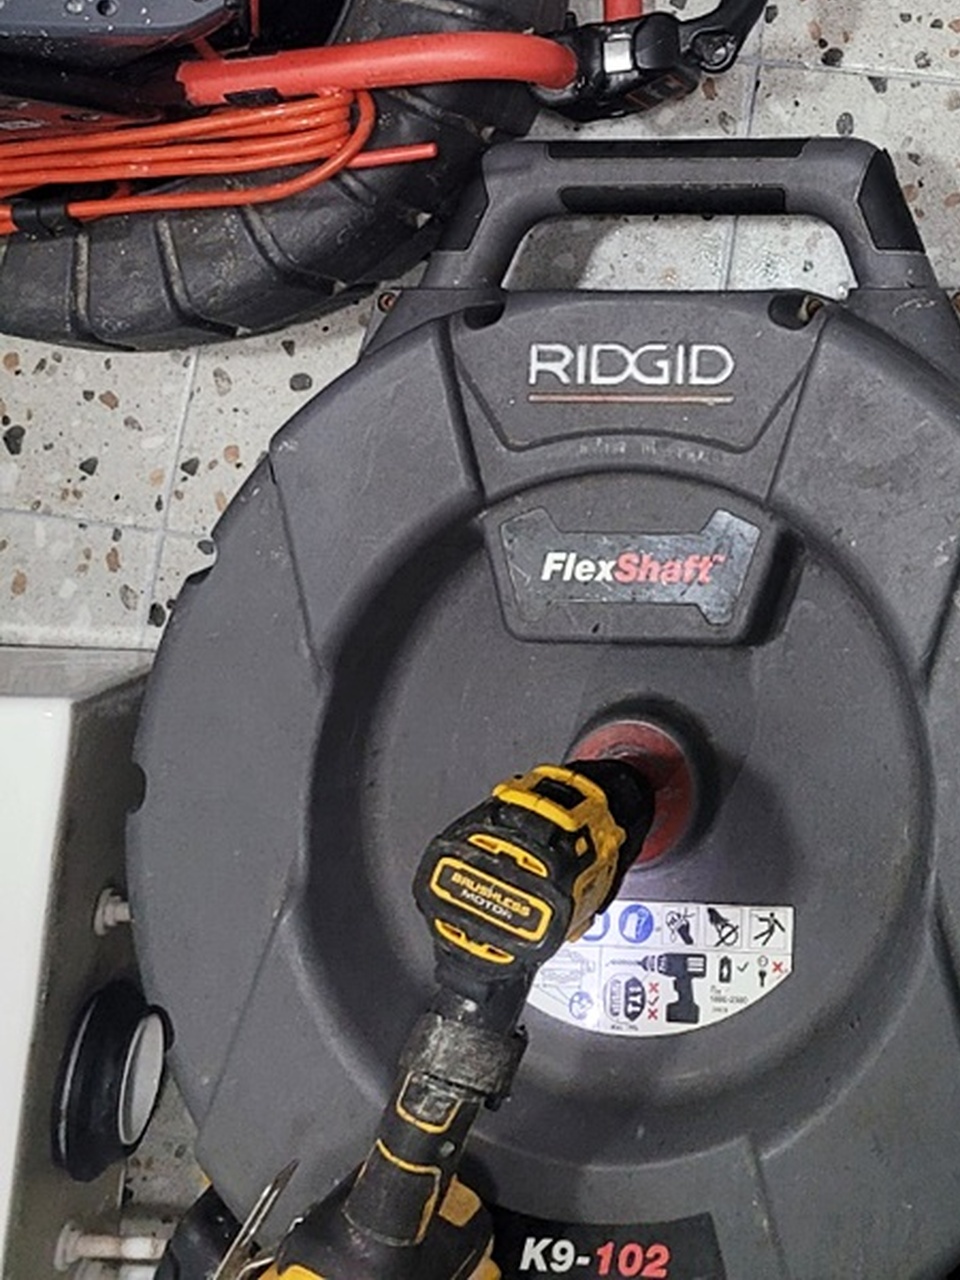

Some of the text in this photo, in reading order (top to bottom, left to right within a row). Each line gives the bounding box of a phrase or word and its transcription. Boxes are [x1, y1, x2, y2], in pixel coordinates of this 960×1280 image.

[529, 343, 735, 385] RIDGID
[451, 871, 531, 917] BRUSHLESS
[461, 888, 514, 920] MOTOR
[519, 1237, 670, 1278] K9-102
